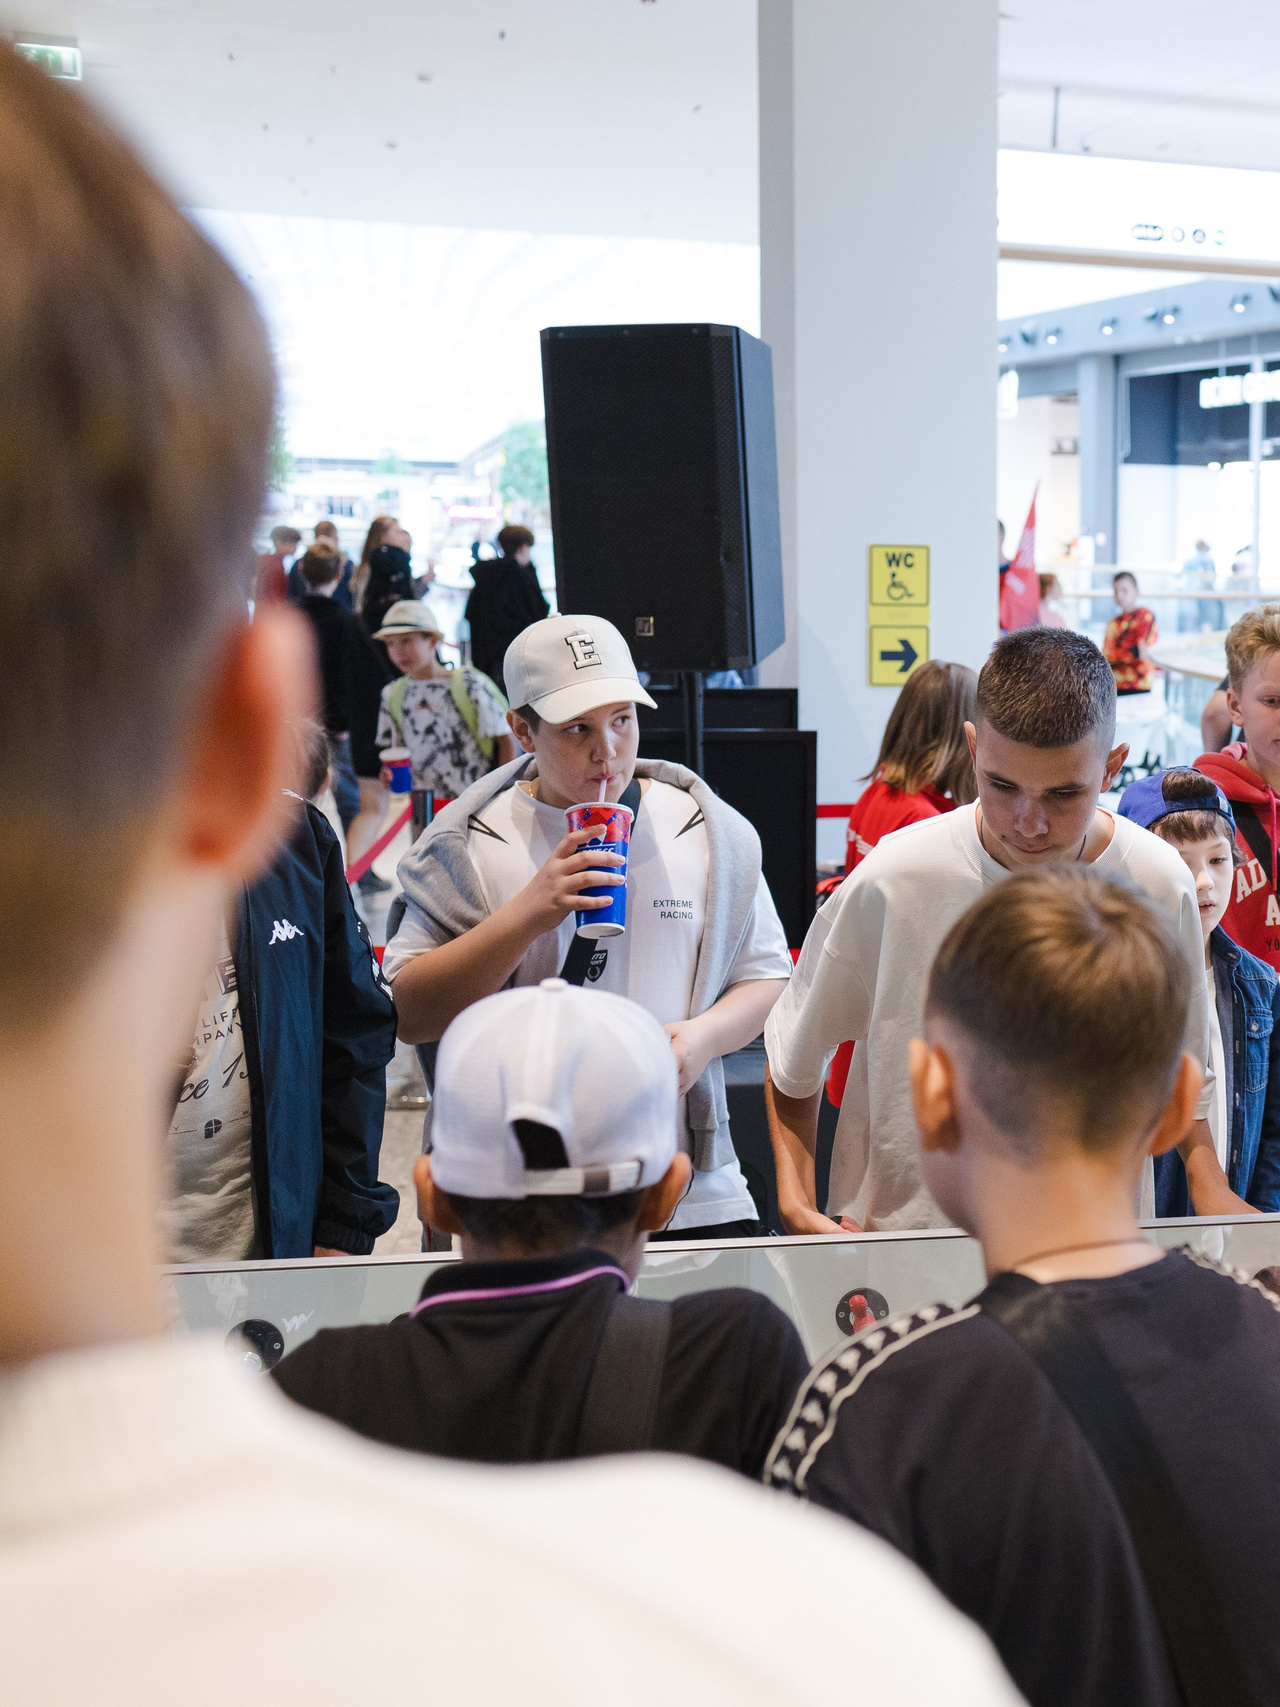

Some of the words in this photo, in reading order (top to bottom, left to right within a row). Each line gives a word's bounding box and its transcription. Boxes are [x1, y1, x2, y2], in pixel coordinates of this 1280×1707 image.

[886, 552, 915, 568] WC
[565, 633, 602, 670] E
[653, 899, 694, 909] EXTREME
[660, 910, 694, 920] RACING
